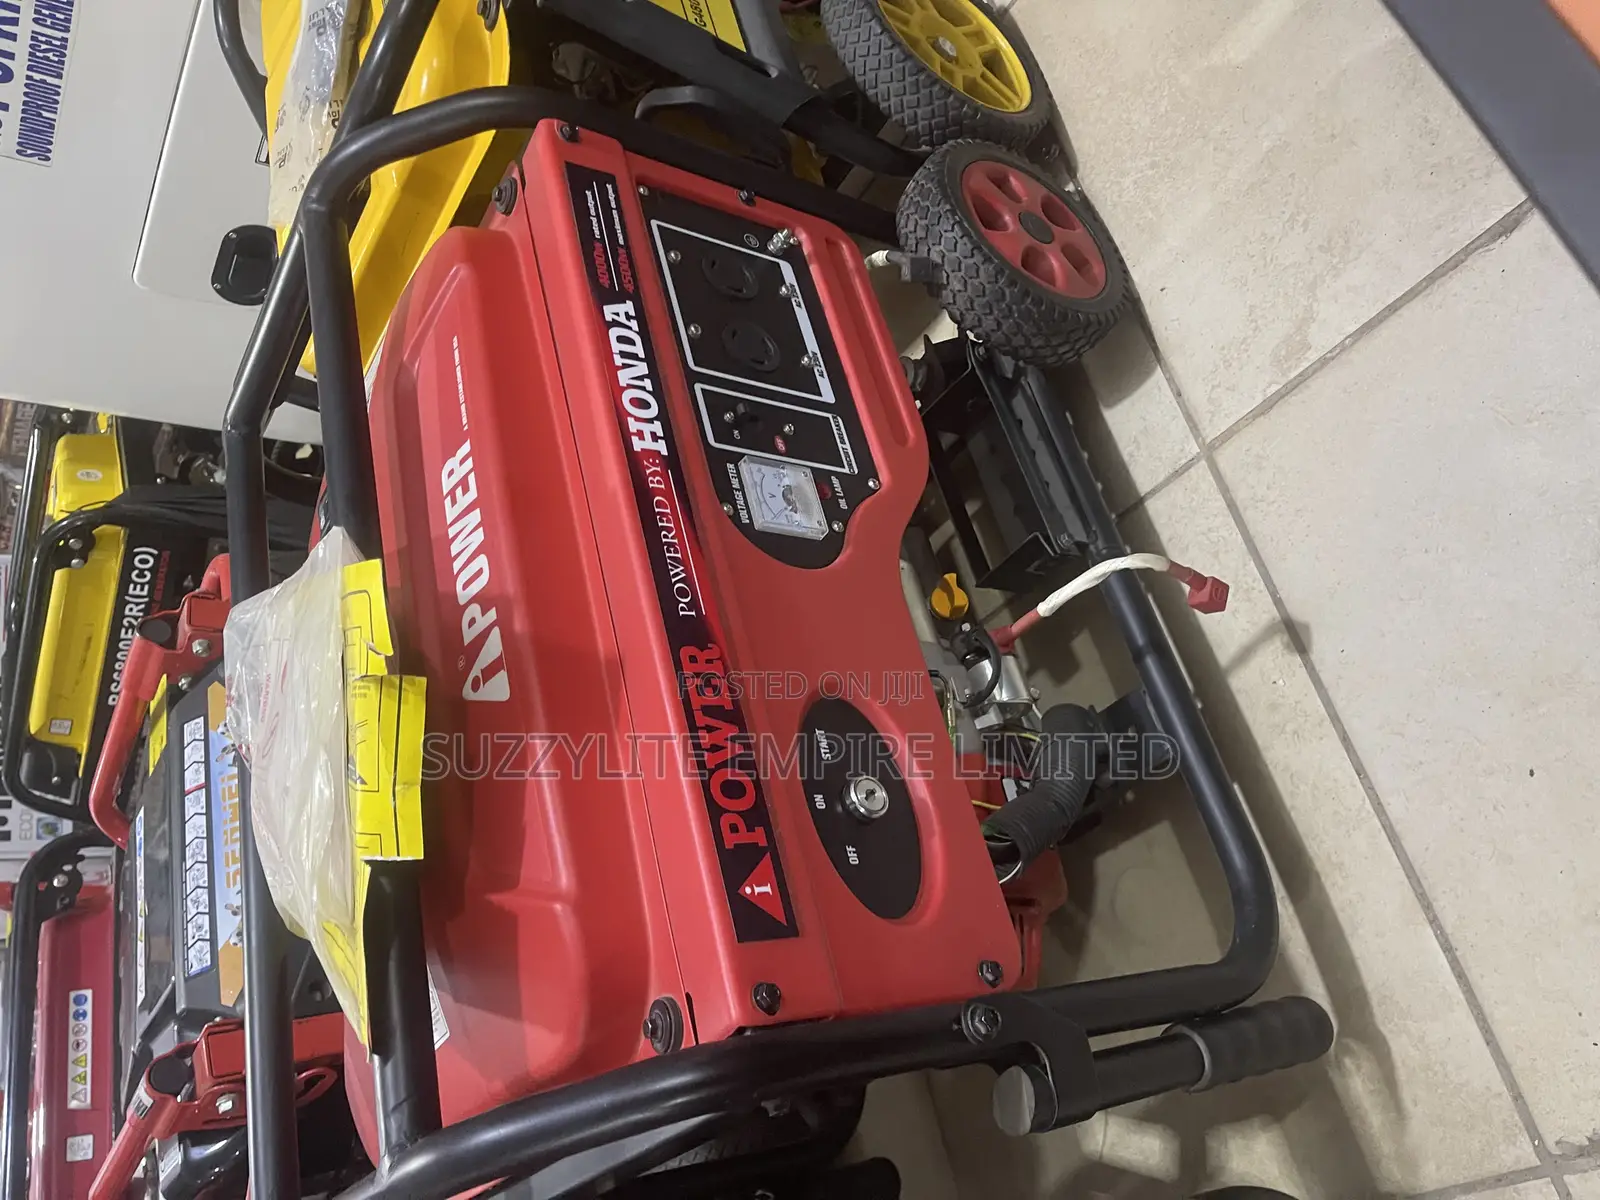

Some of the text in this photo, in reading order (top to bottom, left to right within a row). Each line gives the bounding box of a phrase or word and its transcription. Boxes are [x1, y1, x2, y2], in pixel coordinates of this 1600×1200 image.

[26, 30, 68, 80] DIESEL
[16, 74, 61, 161] SOUNDPROOF
[585, 190, 596, 216] output
[606, 183, 617, 209] output
[590, 216, 600, 239] rated
[612, 209, 624, 246] maximum
[733, 429, 741, 440] ON
[603, 300, 696, 617] POWERED BY: HONDA
[841, 445, 856, 474] CIRCUIT
[726, 462, 750, 524] VOLTAGE METER
[831, 475, 848, 510] OIL LAMP
[441, 438, 497, 647] POWER
[679, 643, 769, 849] POWER
[815, 728, 832, 761] START
[813, 794, 826, 810] ON
[846, 845, 860, 865] OFF
